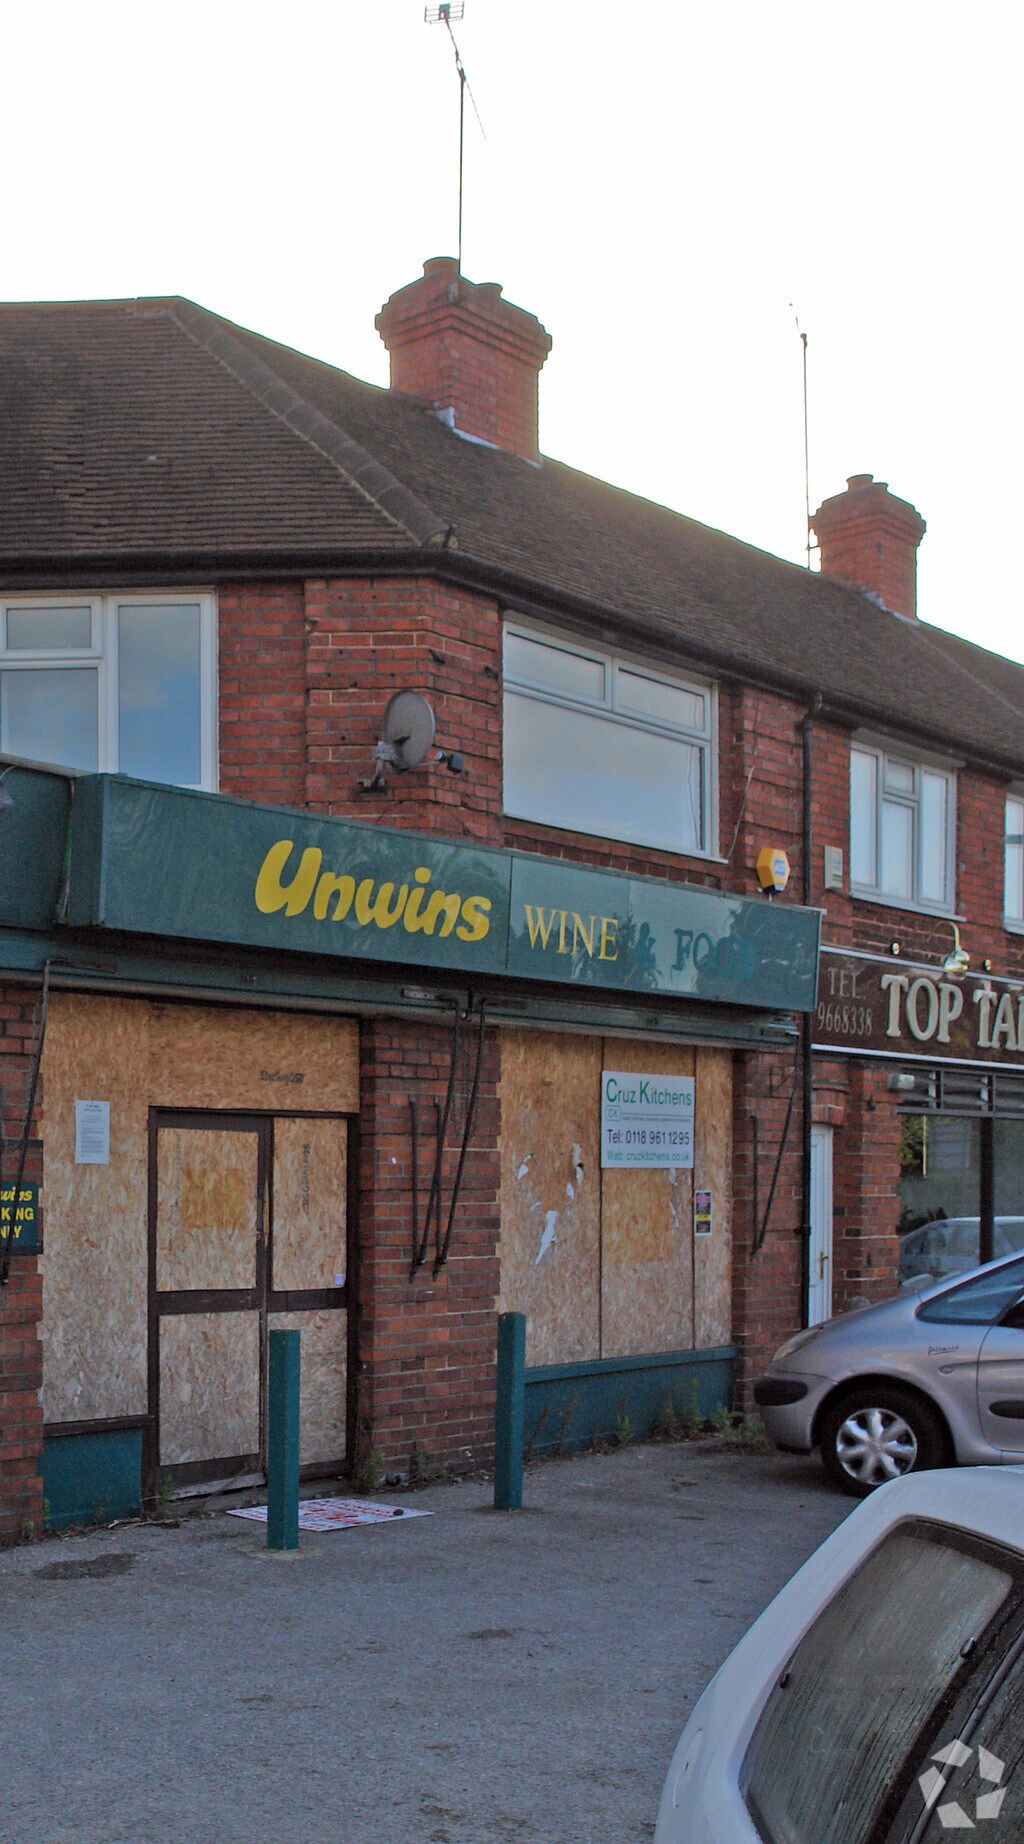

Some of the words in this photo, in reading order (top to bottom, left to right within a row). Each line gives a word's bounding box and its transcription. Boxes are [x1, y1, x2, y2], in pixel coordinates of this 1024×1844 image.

[255, 840, 492, 942] Unwins
[524, 904, 619, 962] WINE
[817, 1001, 873, 1036] 9668338
[880, 973, 964, 1044] TOP
[606, 1078, 636, 1103] Cruz
[639, 1080, 692, 1106] Kitchens
[607, 1128, 624, 1144] Tel:
[625, 1130, 647, 1145] 0118
